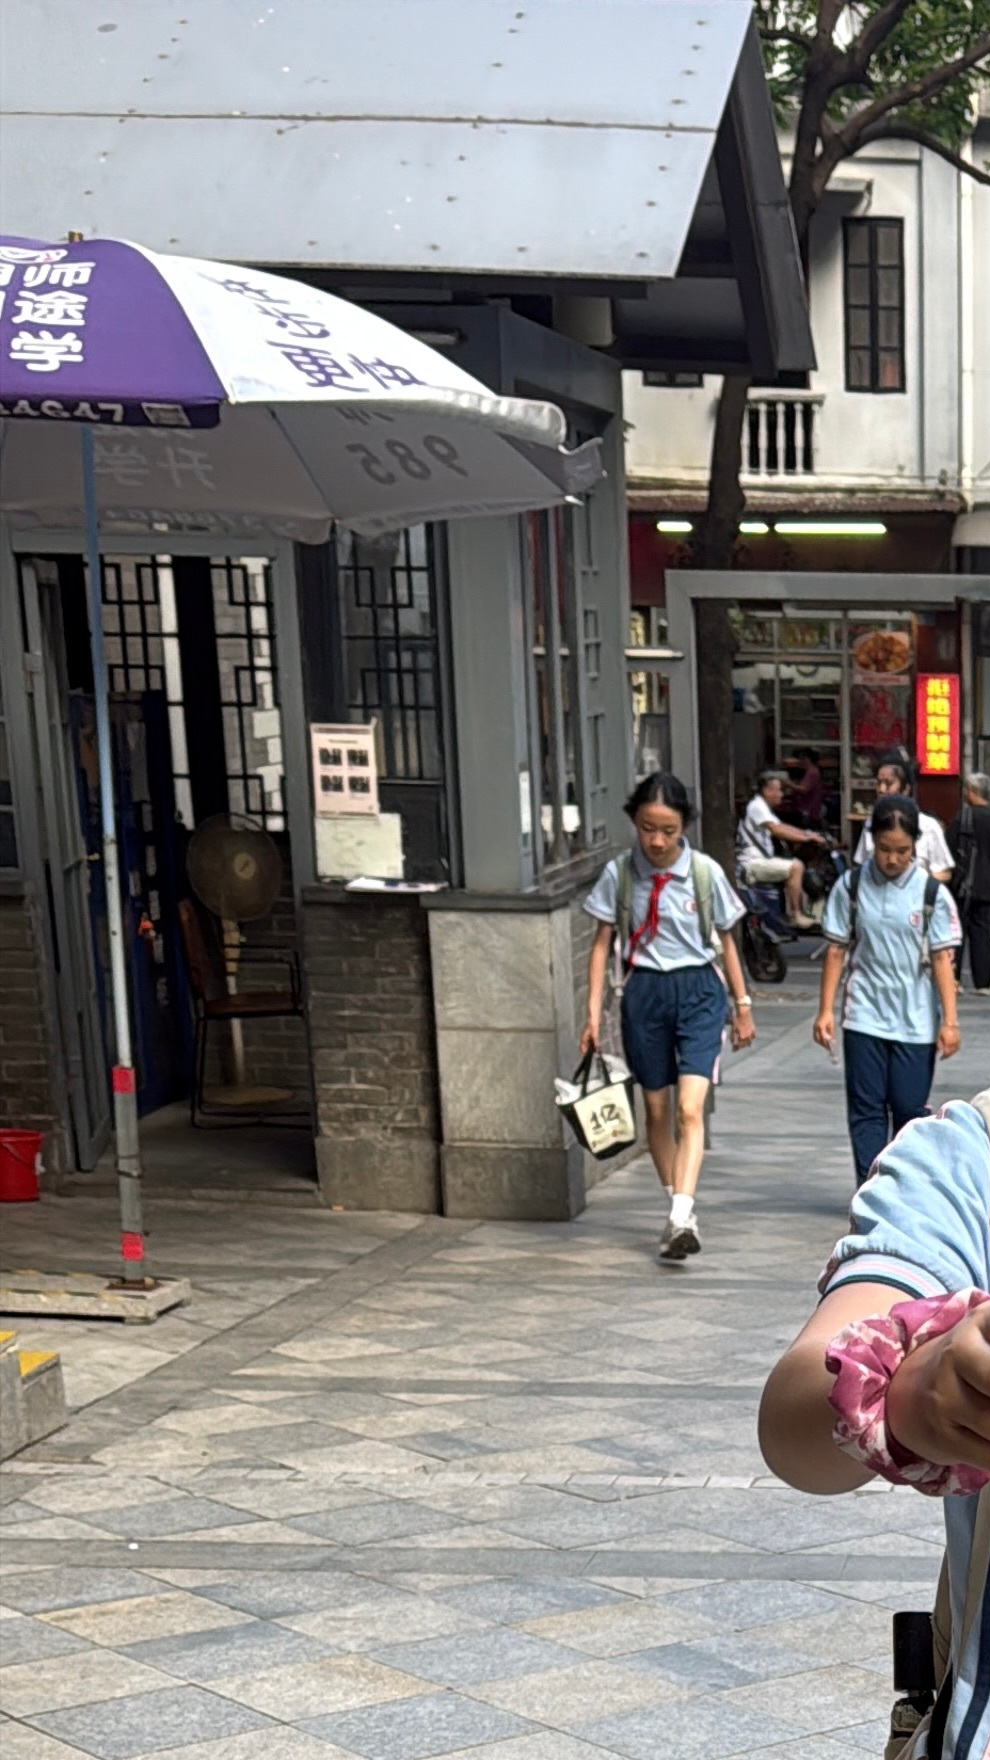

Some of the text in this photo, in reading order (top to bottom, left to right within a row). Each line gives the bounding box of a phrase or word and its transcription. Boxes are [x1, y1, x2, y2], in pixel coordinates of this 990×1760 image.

[0, 262, 96, 287] 师
[0, 290, 88, 326] 途
[9, 330, 84, 372] 学
[266, 340, 426, 392] 更快
